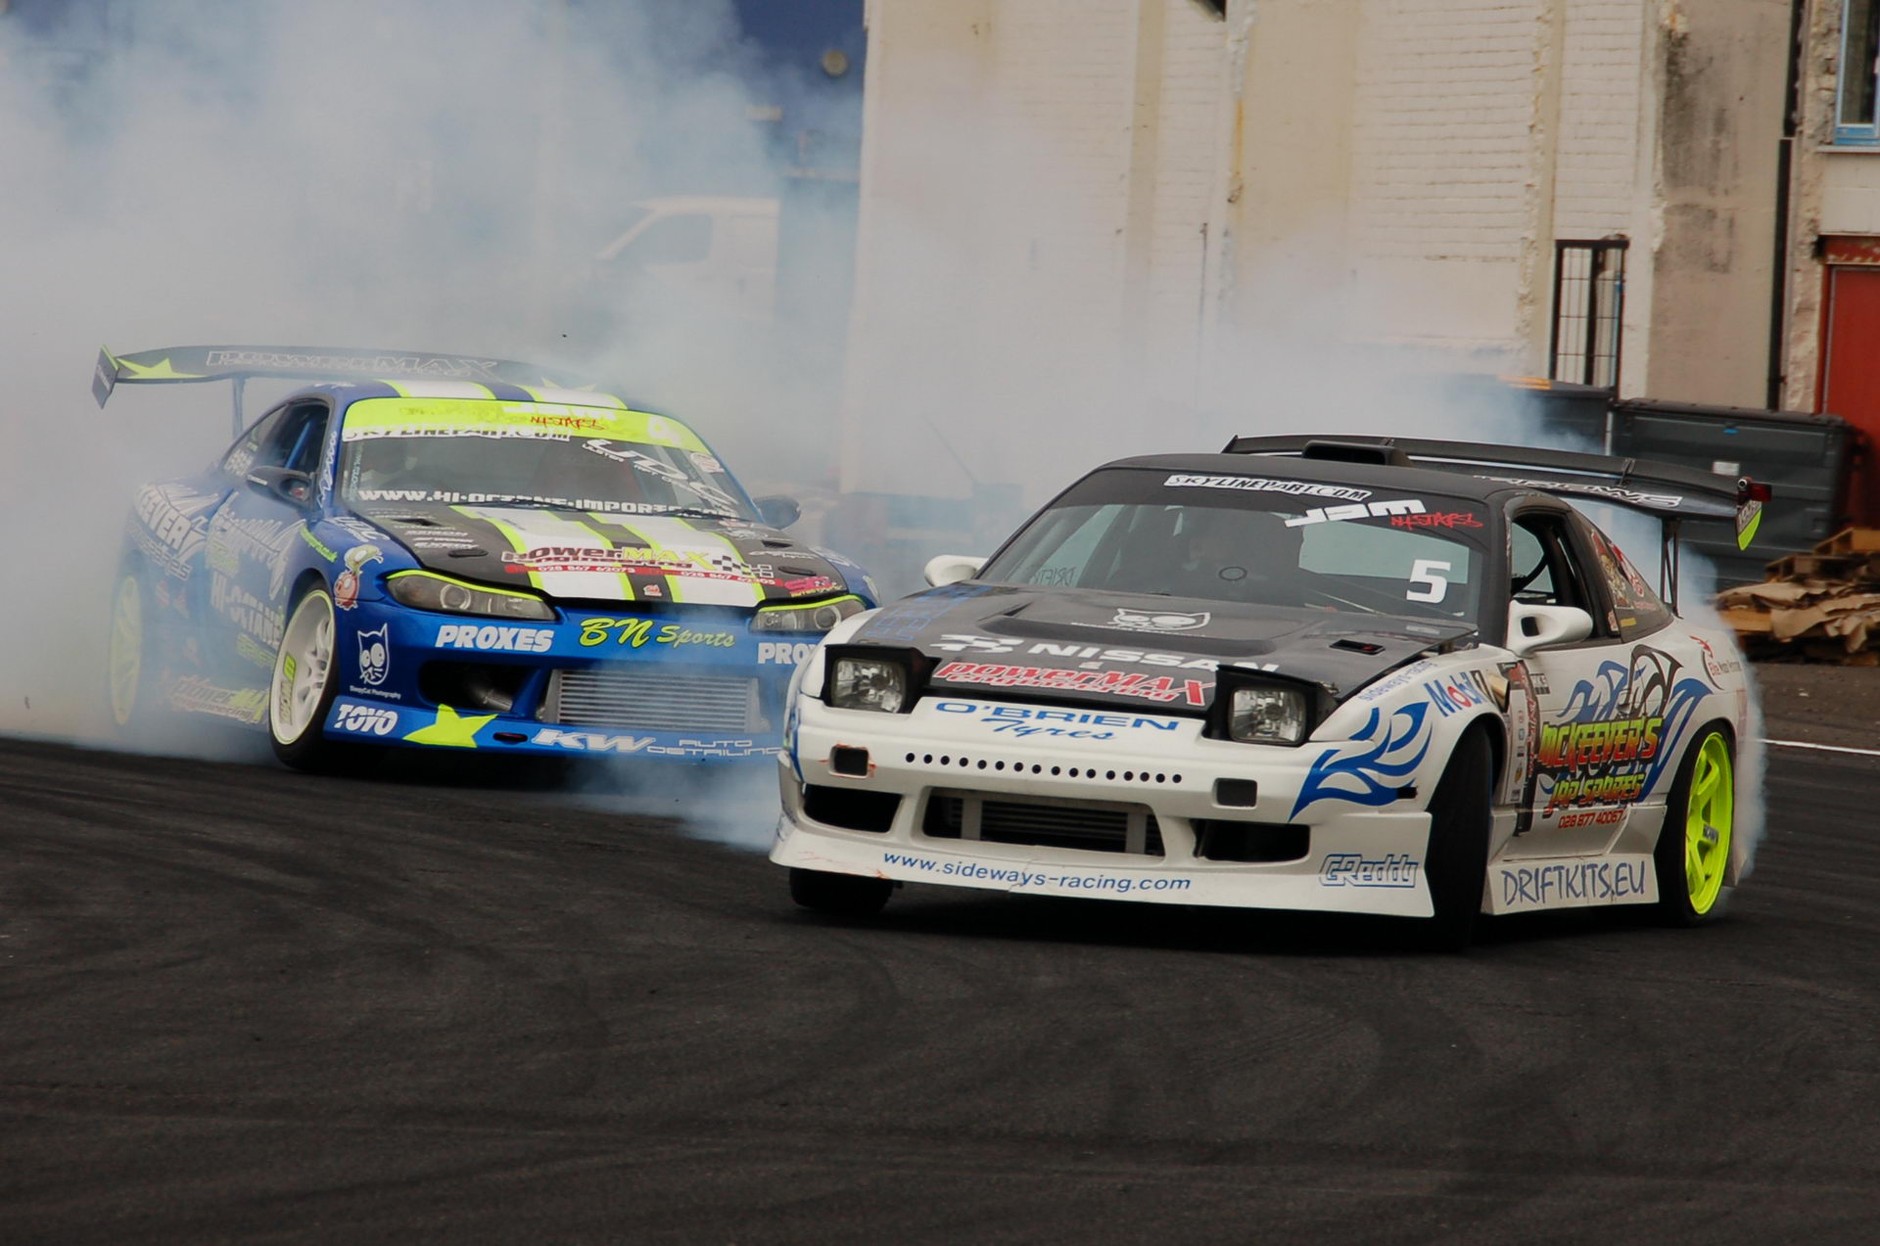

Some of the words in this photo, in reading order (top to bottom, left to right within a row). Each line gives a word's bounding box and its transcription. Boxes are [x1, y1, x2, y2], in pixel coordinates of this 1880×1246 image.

[1166, 475, 1371, 501] SKYLINEPART.COM
[1406, 559, 1451, 604] 5
[435, 624, 554, 653] PROXES
[578, 617, 654, 648] BN
[656, 625, 736, 648] Sports
[1423, 671, 1487, 717] Mobil
[334, 704, 398, 735] TOYO
[935, 702, 1179, 731] O'BRIEN
[981, 719, 1118, 741] Tyres
[532, 729, 656, 753] KW
[679, 740, 753, 748] AUTO
[1558, 814, 1577, 829] 028
[883, 852, 1191, 893] www.sideways-racing.com
[1318, 853, 1420, 888] GReddy
[1501, 861, 1646, 905] DRIFTKITS.EU
